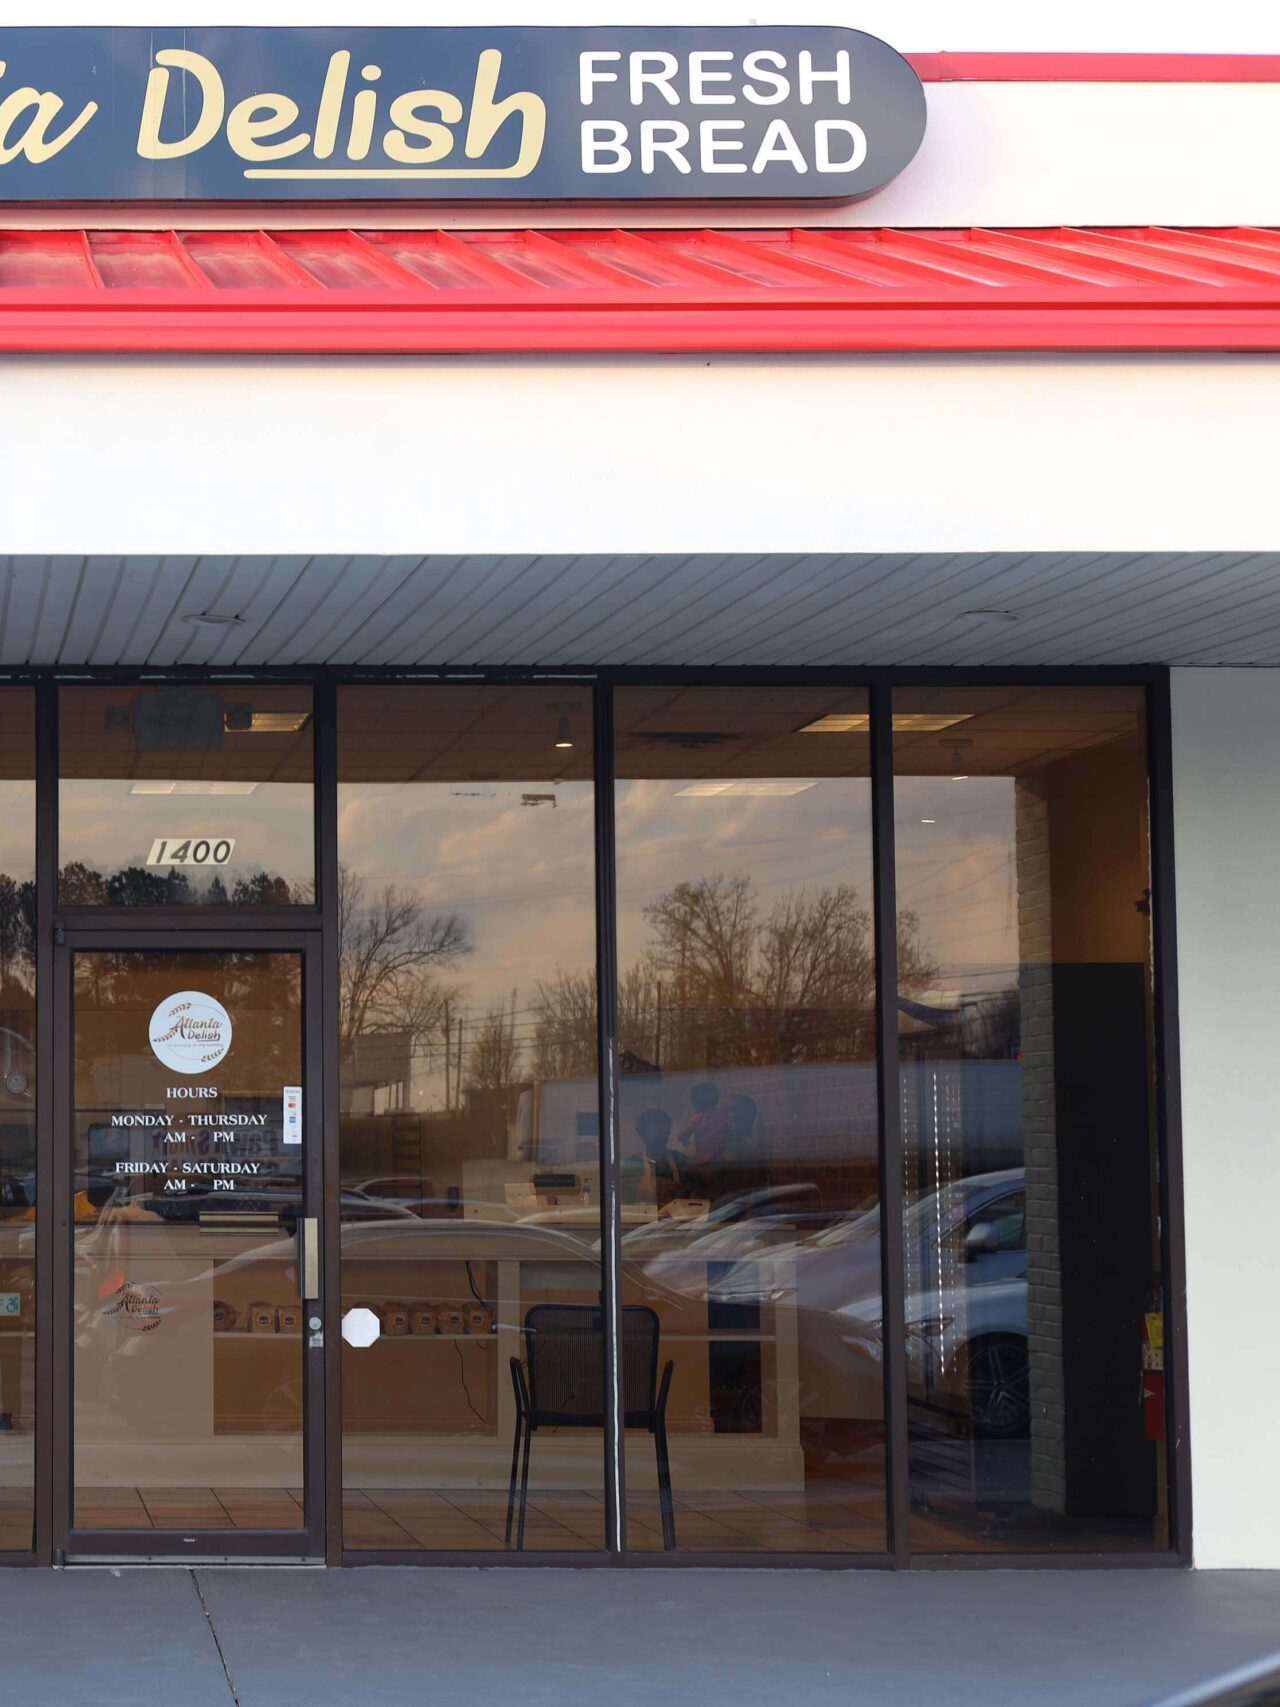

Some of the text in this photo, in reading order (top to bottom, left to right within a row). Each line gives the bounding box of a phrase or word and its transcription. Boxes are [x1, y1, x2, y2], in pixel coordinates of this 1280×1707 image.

[579, 50, 850, 105] FRESH
[136, 48, 546, 178] Delish
[580, 119, 868, 174] BREAD
[155, 840, 231, 864] 1400
[173, 1016, 223, 1039] Atlanta
[187, 1031, 221, 1042] Delish
[166, 1087, 218, 1098] HOURS
[111, 1115, 174, 1127] MONDAY
[188, 1114, 268, 1126] THURSDAY
[163, 1131, 187, 1143] AM
[213, 1131, 235, 1143] PM
[115, 1162, 169, 1174] FRIDAY
[182, 1162, 261, 1174] SATURDAY
[163, 1179, 187, 1190] AM
[213, 1179, 235, 1190] PM
